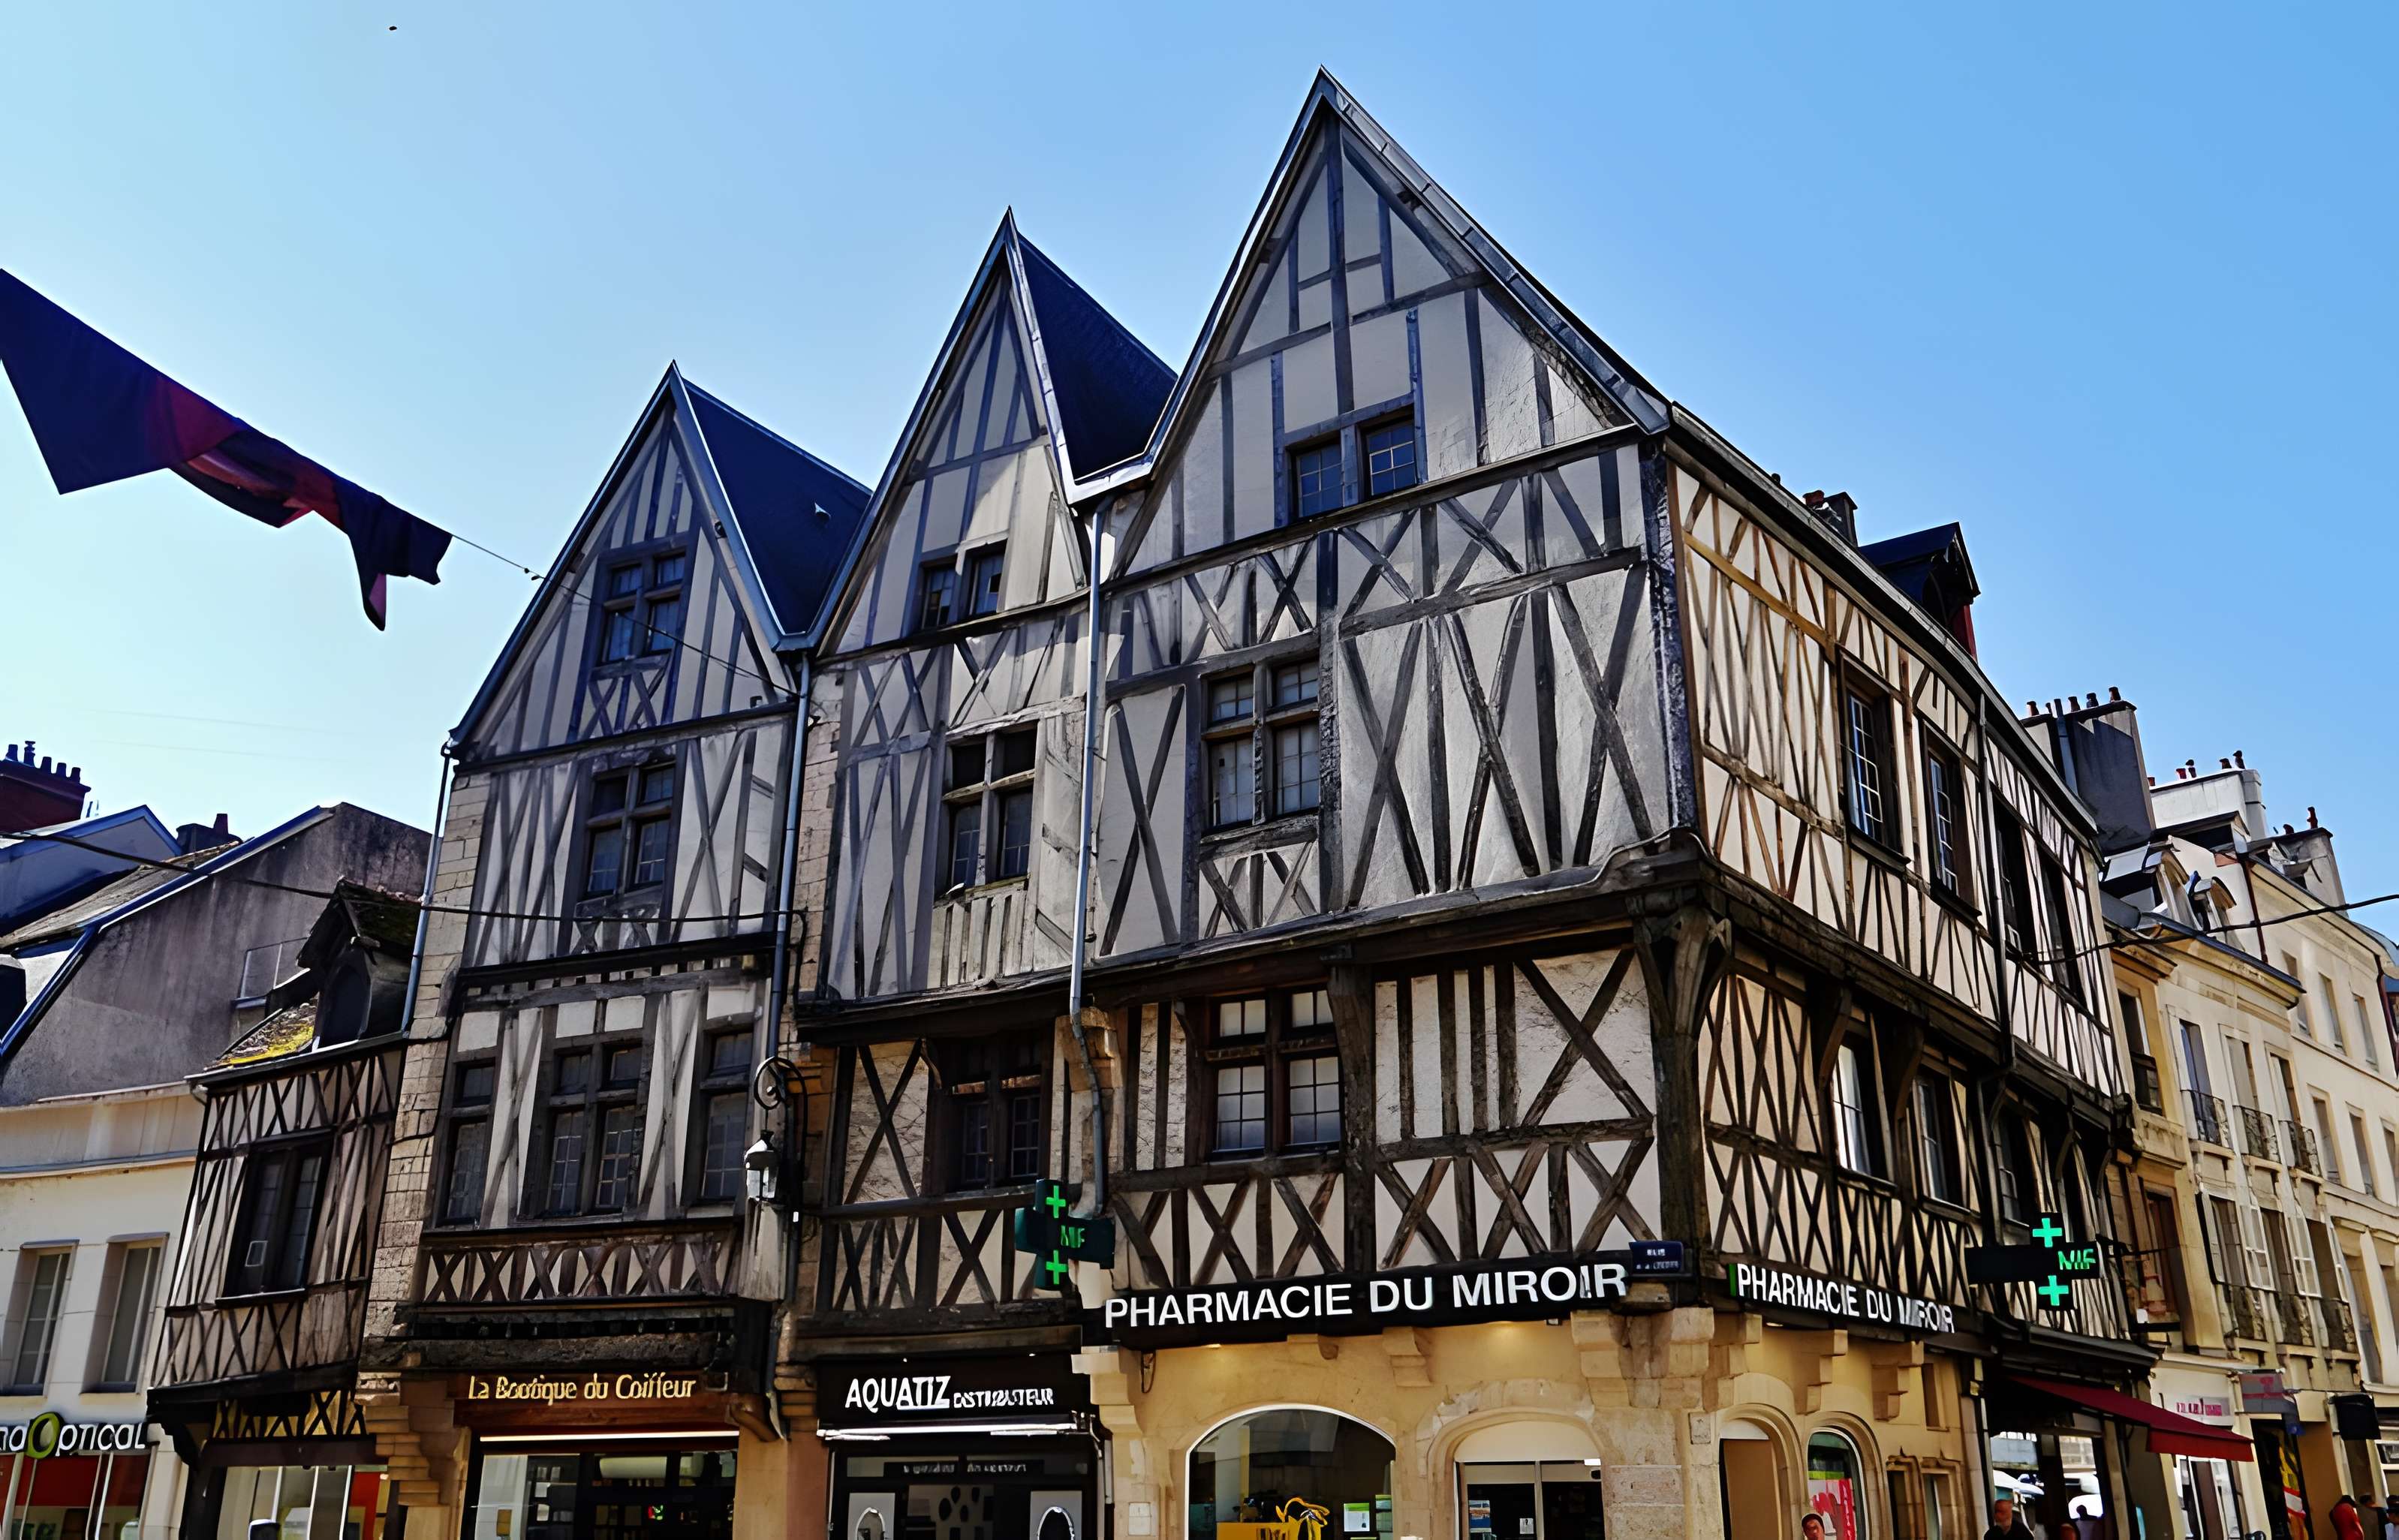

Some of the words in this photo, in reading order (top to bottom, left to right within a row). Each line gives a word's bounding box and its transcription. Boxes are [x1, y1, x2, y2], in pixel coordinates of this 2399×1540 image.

[1106, 1283, 1353, 1328] PHARMACIE
[1369, 1277, 1433, 1313] DU
[1452, 1263, 1627, 1308] MIROIR
[1737, 1263, 1860, 1316] PHARMACIE
[1866, 1289, 1892, 1322] DU
[468, 1375, 489, 1399] La
[583, 1373, 609, 1399] du
[616, 1372, 697, 1399] Coiffeur
[844, 1376, 951, 1413] AQUATIZ
